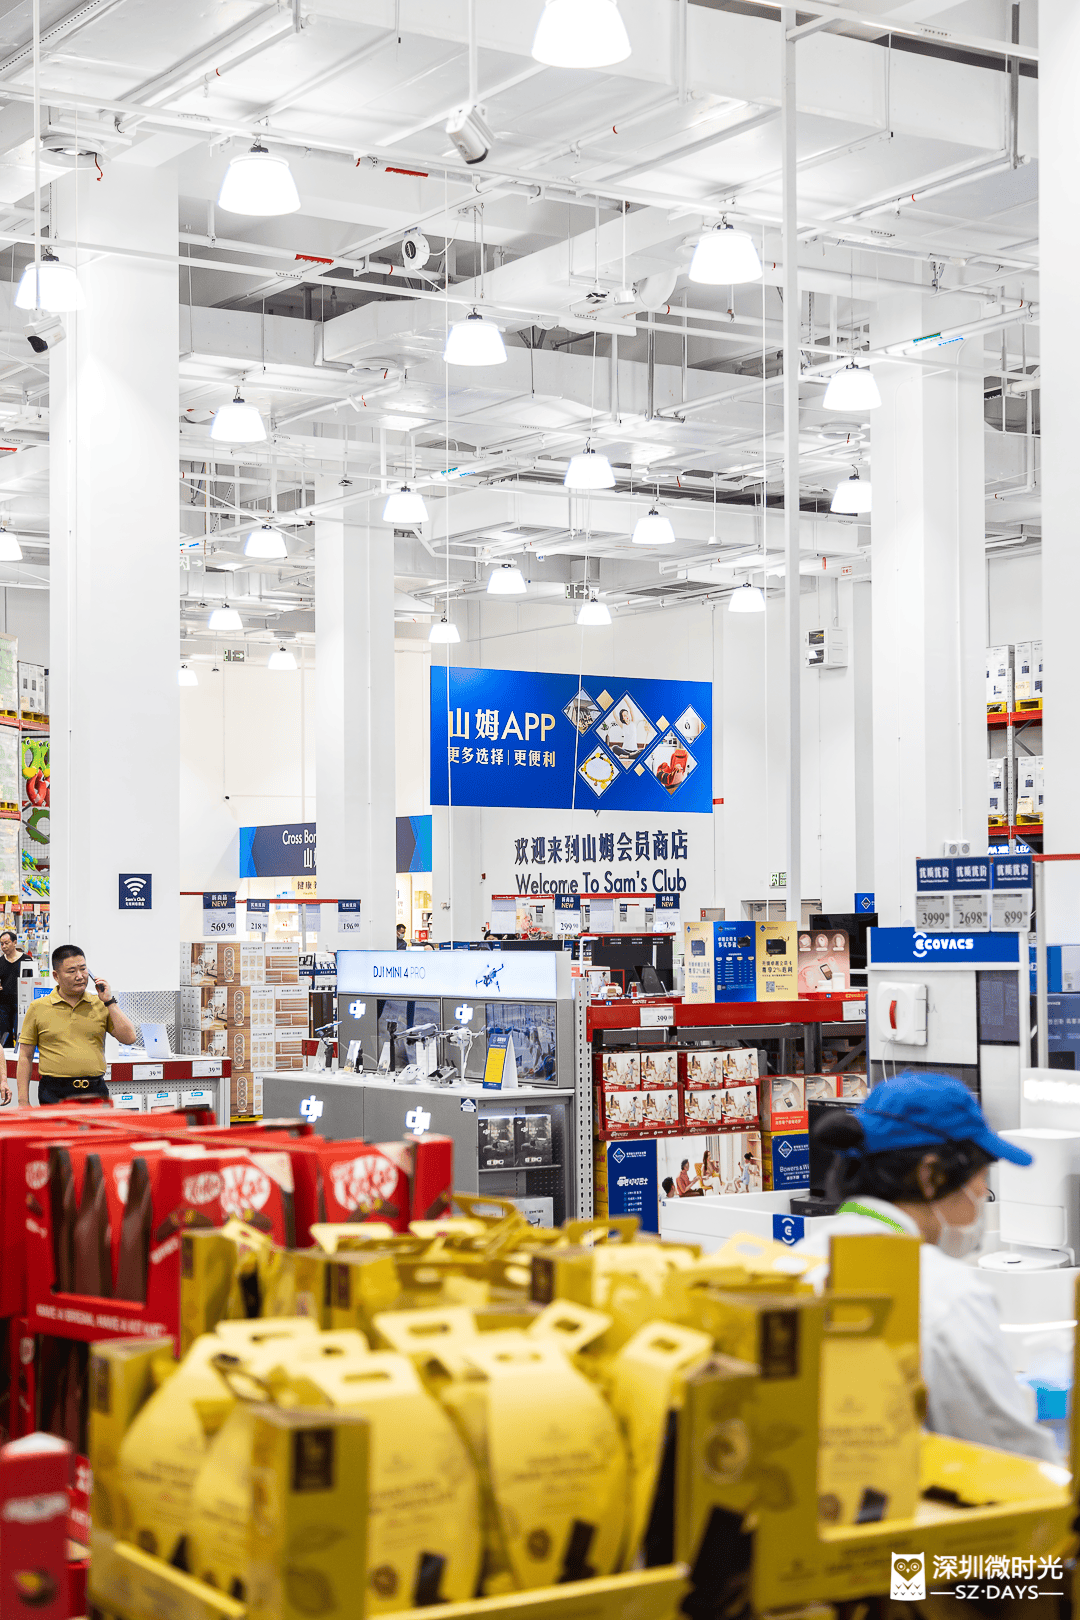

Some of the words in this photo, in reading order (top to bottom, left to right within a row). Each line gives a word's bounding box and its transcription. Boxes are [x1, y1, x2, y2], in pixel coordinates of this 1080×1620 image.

[448, 707, 556, 742] 山姆APP
[447, 746, 505, 766] 更多选择
[513, 749, 556, 768] 更便利
[282, 829, 303, 845] Cross
[514, 829, 689, 866] 欢迎来到山姆会员商店
[515, 872, 579, 895] Welcome
[582, 871, 599, 893] To
[604, 869, 648, 893] Sam's
[652, 868, 687, 892] Club
[914, 937, 974, 951] ECOVACS
[373, 965, 385, 978] DJI
[385, 966, 402, 978] MINI
[403, 967, 409, 979] 4
[410, 966, 426, 979] PRO
